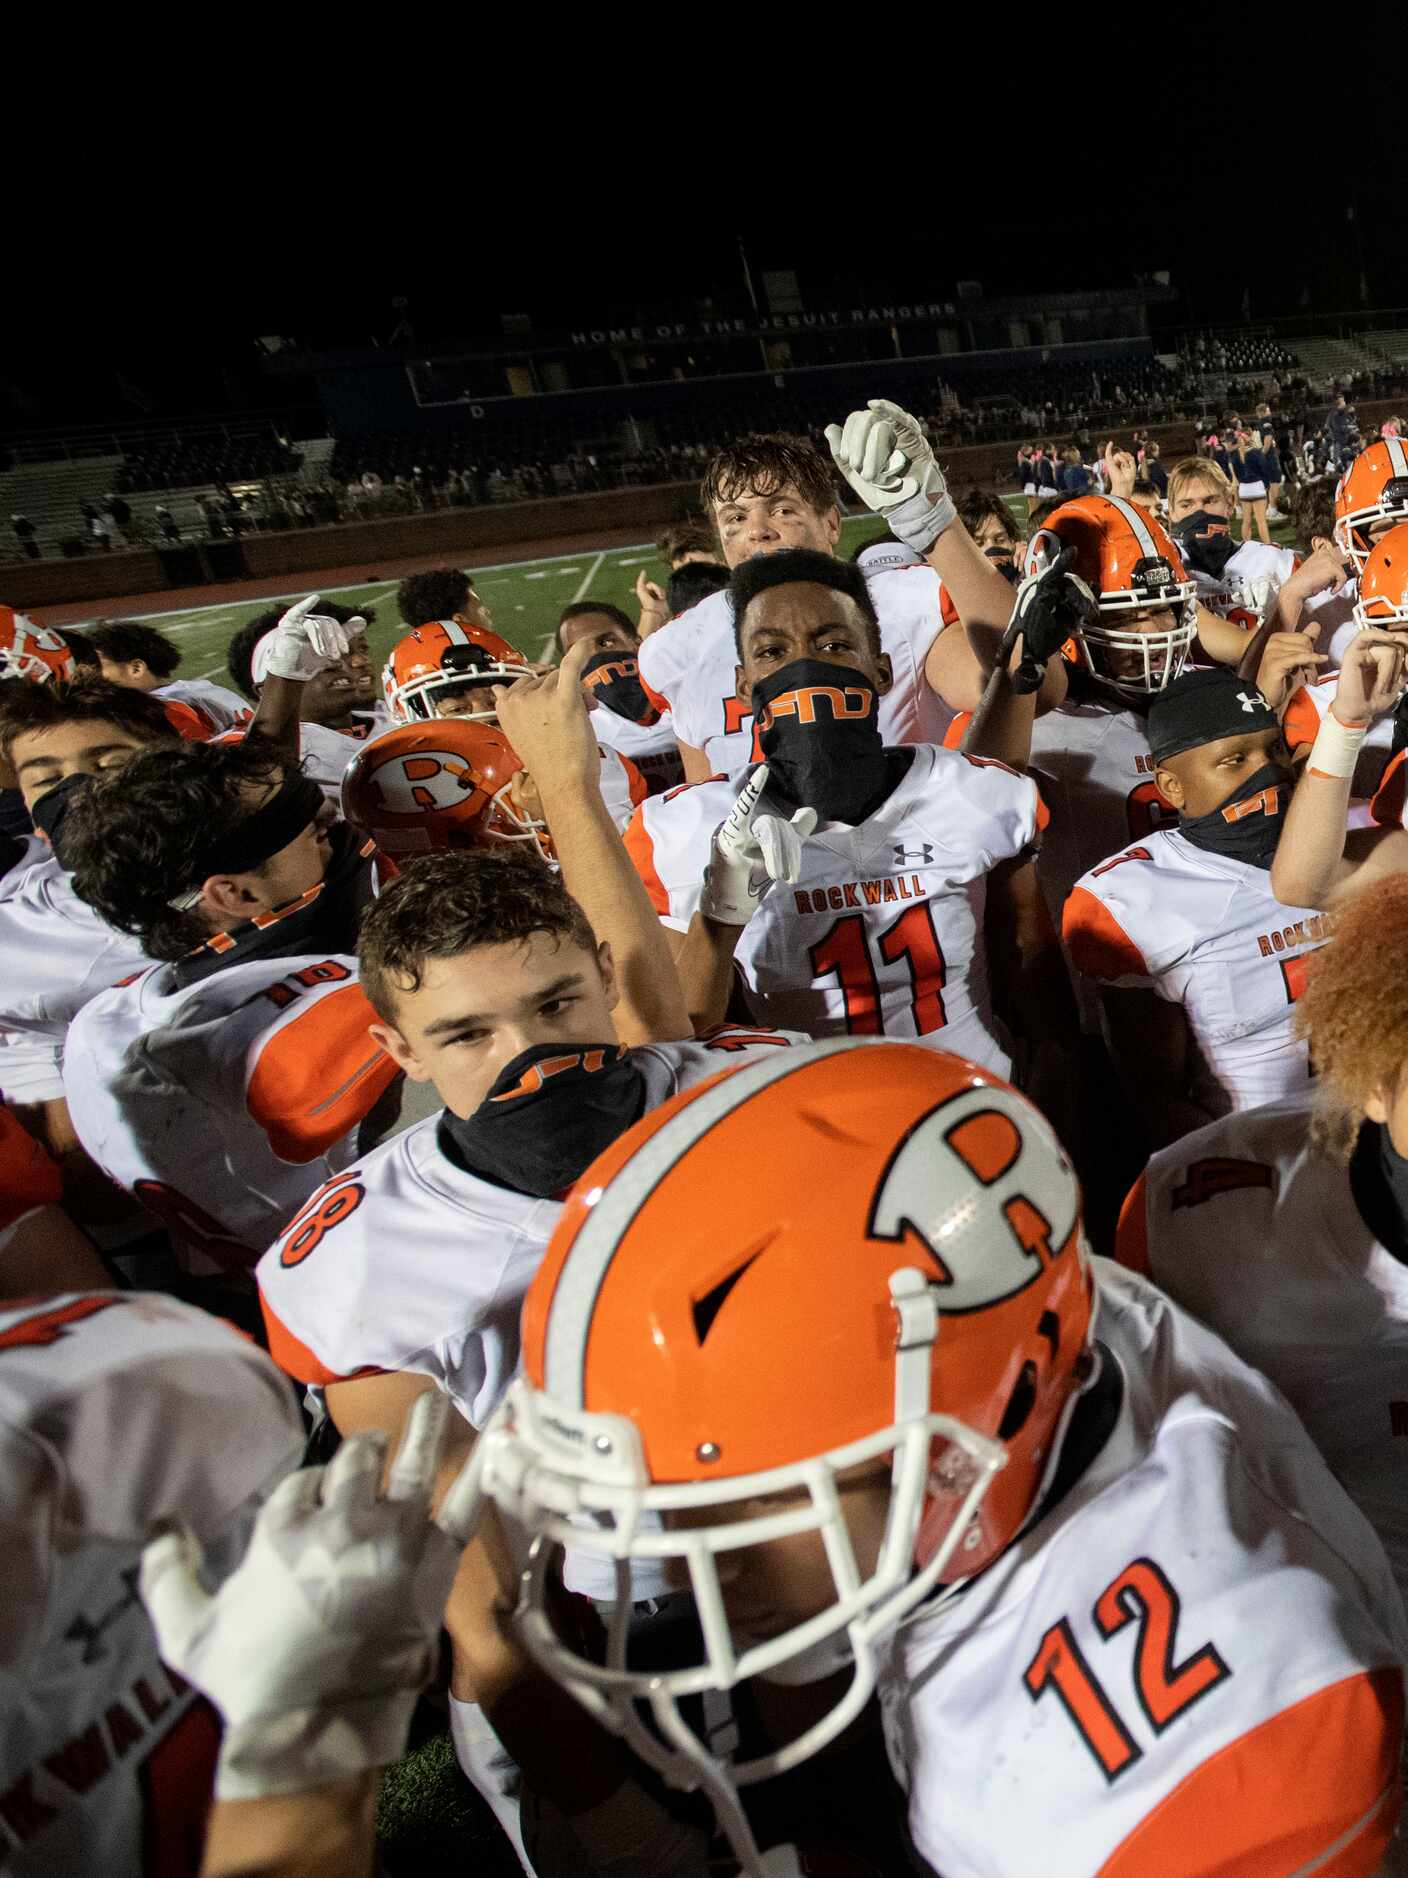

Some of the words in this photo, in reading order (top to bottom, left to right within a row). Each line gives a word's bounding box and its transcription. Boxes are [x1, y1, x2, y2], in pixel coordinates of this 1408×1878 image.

[571, 327, 641, 345] HOME
[657, 323, 687, 338] OF
[703, 319, 745, 335] THE
[759, 311, 839, 329] JESUIT
[851, 302, 956, 321] RANGERS
[795, 875, 926, 914] ROCKWALL
[808, 900, 948, 1037] 11
[865, 1085, 1080, 1316] R
[1023, 1556, 1231, 1783] 12
